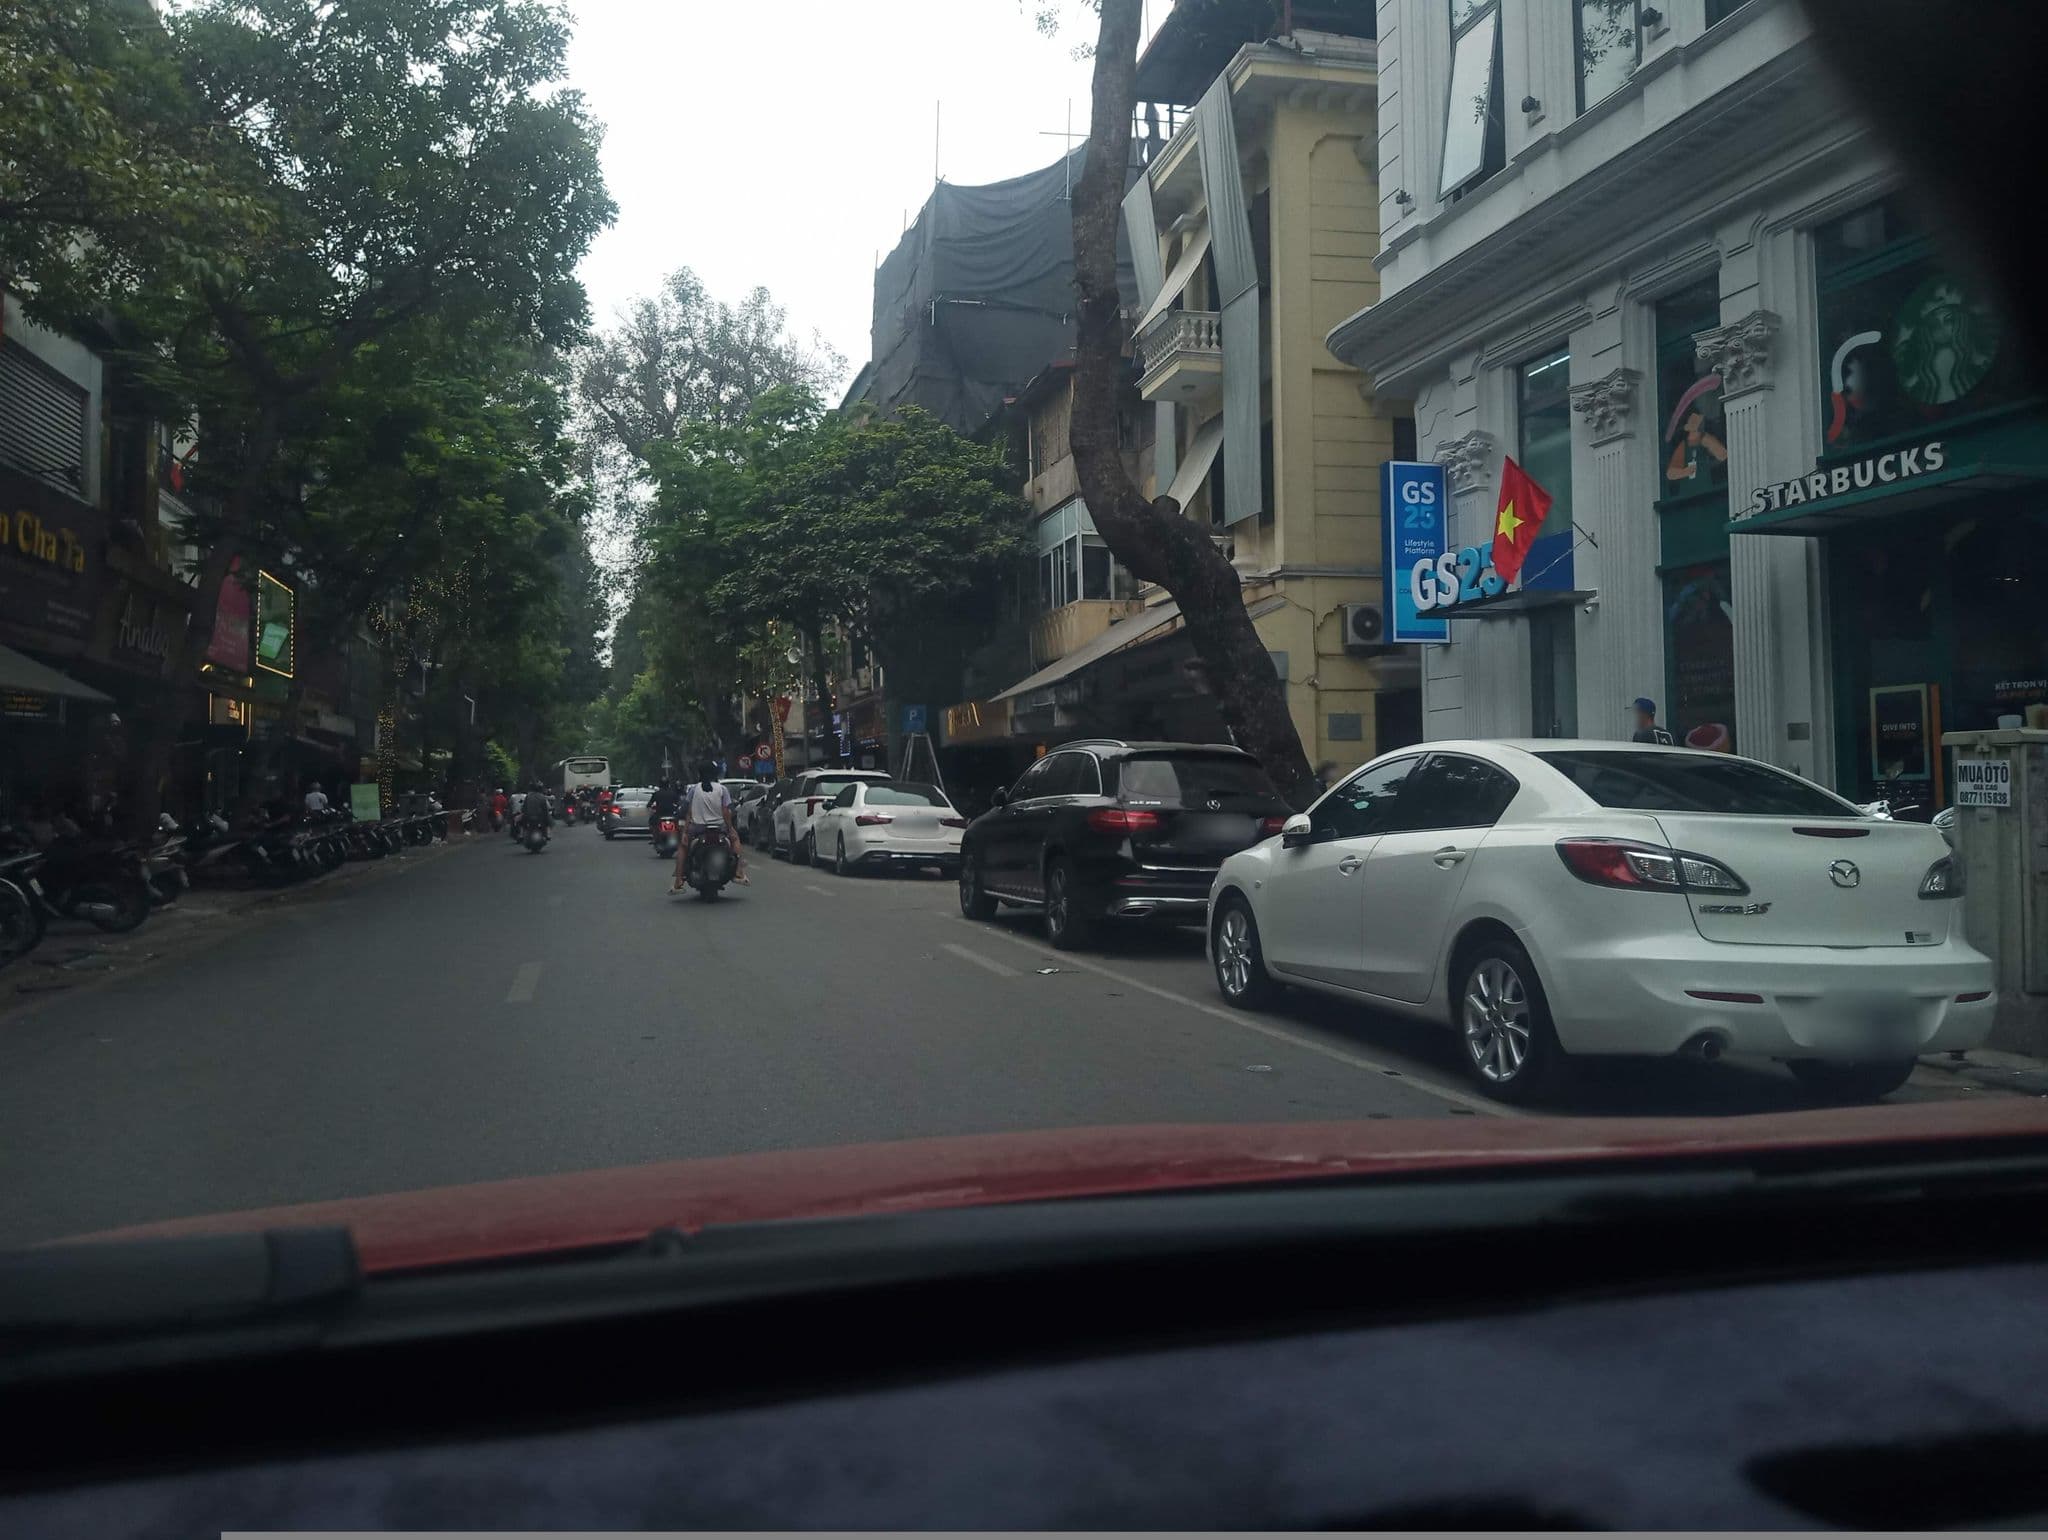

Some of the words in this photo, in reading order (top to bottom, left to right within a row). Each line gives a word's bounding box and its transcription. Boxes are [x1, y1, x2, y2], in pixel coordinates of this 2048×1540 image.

[1751, 442, 1945, 514] STARBUCKS
[1402, 481, 1436, 504] GS
[1404, 504, 1435, 528] 25
[1404, 539, 1435, 548] Lifestyle
[1404, 547, 1436, 555] Platform
[1411, 542, 1505, 611] GS25
[1958, 765, 1983, 783] MUA
